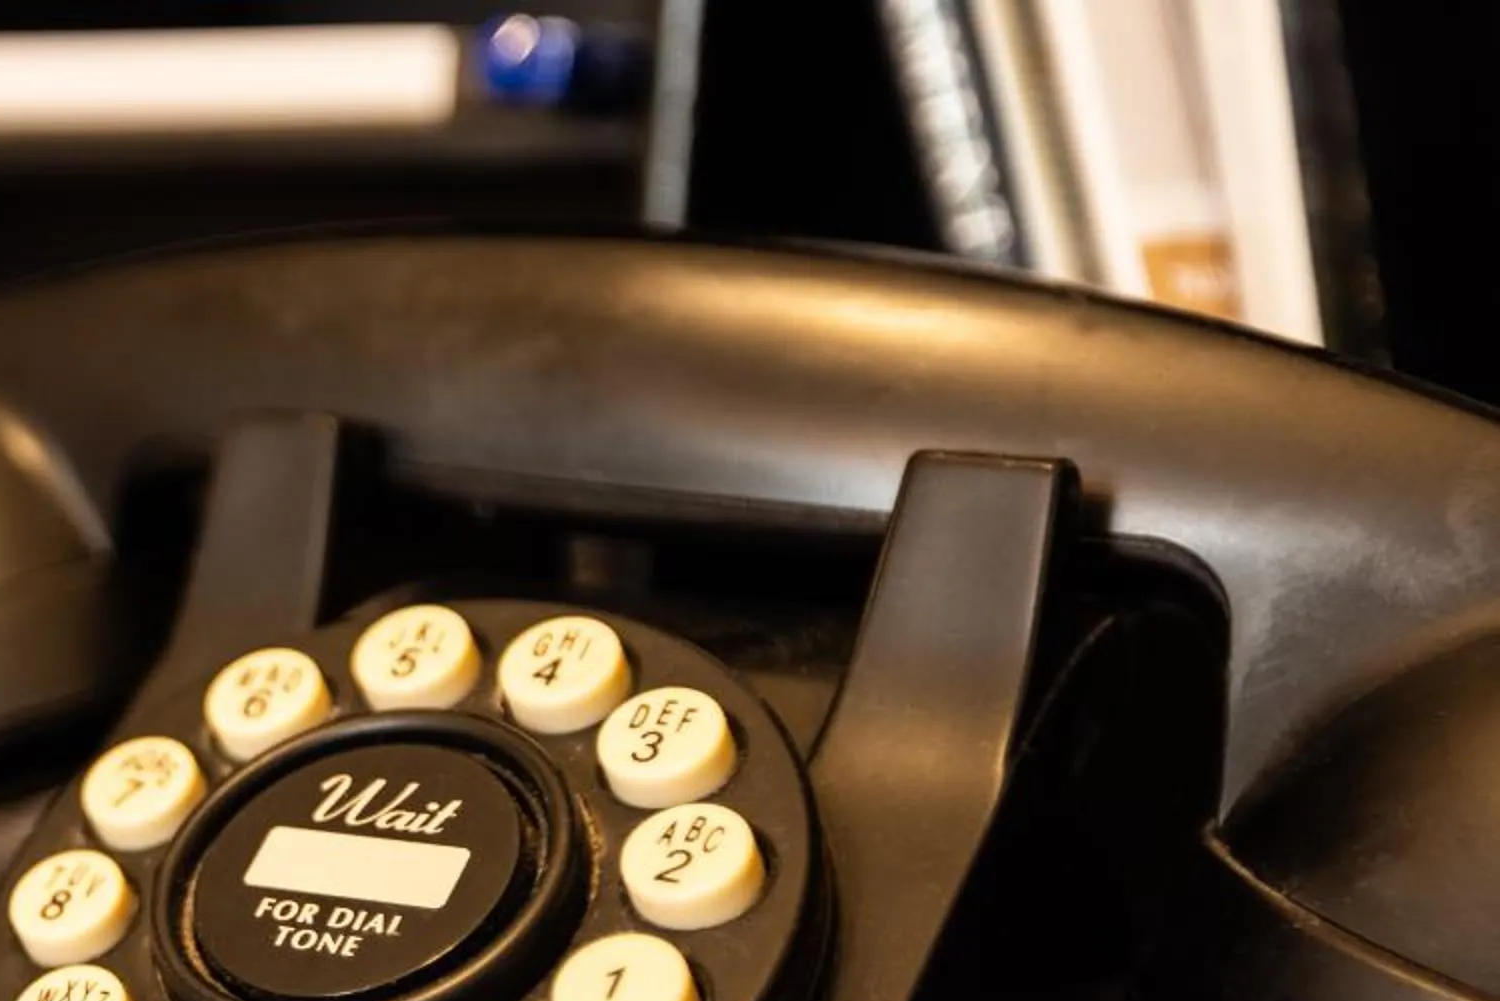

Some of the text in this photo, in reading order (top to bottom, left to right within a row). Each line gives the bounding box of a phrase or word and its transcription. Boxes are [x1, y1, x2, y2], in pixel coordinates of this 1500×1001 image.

[532, 629, 593, 661] GHI
[390, 646, 423, 678] 5
[531, 657, 563, 687] 4
[242, 687, 273, 719] 6
[628, 699, 699, 733] DEF
[631, 731, 664, 763] 3
[112, 778, 145, 808] 7
[311, 773, 464, 835] Wait
[655, 815, 725, 854] ABC
[652, 848, 694, 884] 2
[39, 890, 72, 921] 8
[254, 896, 403, 937] FOR DIAL
[274, 925, 364, 957] TONE
[605, 966, 627, 1001] 1
